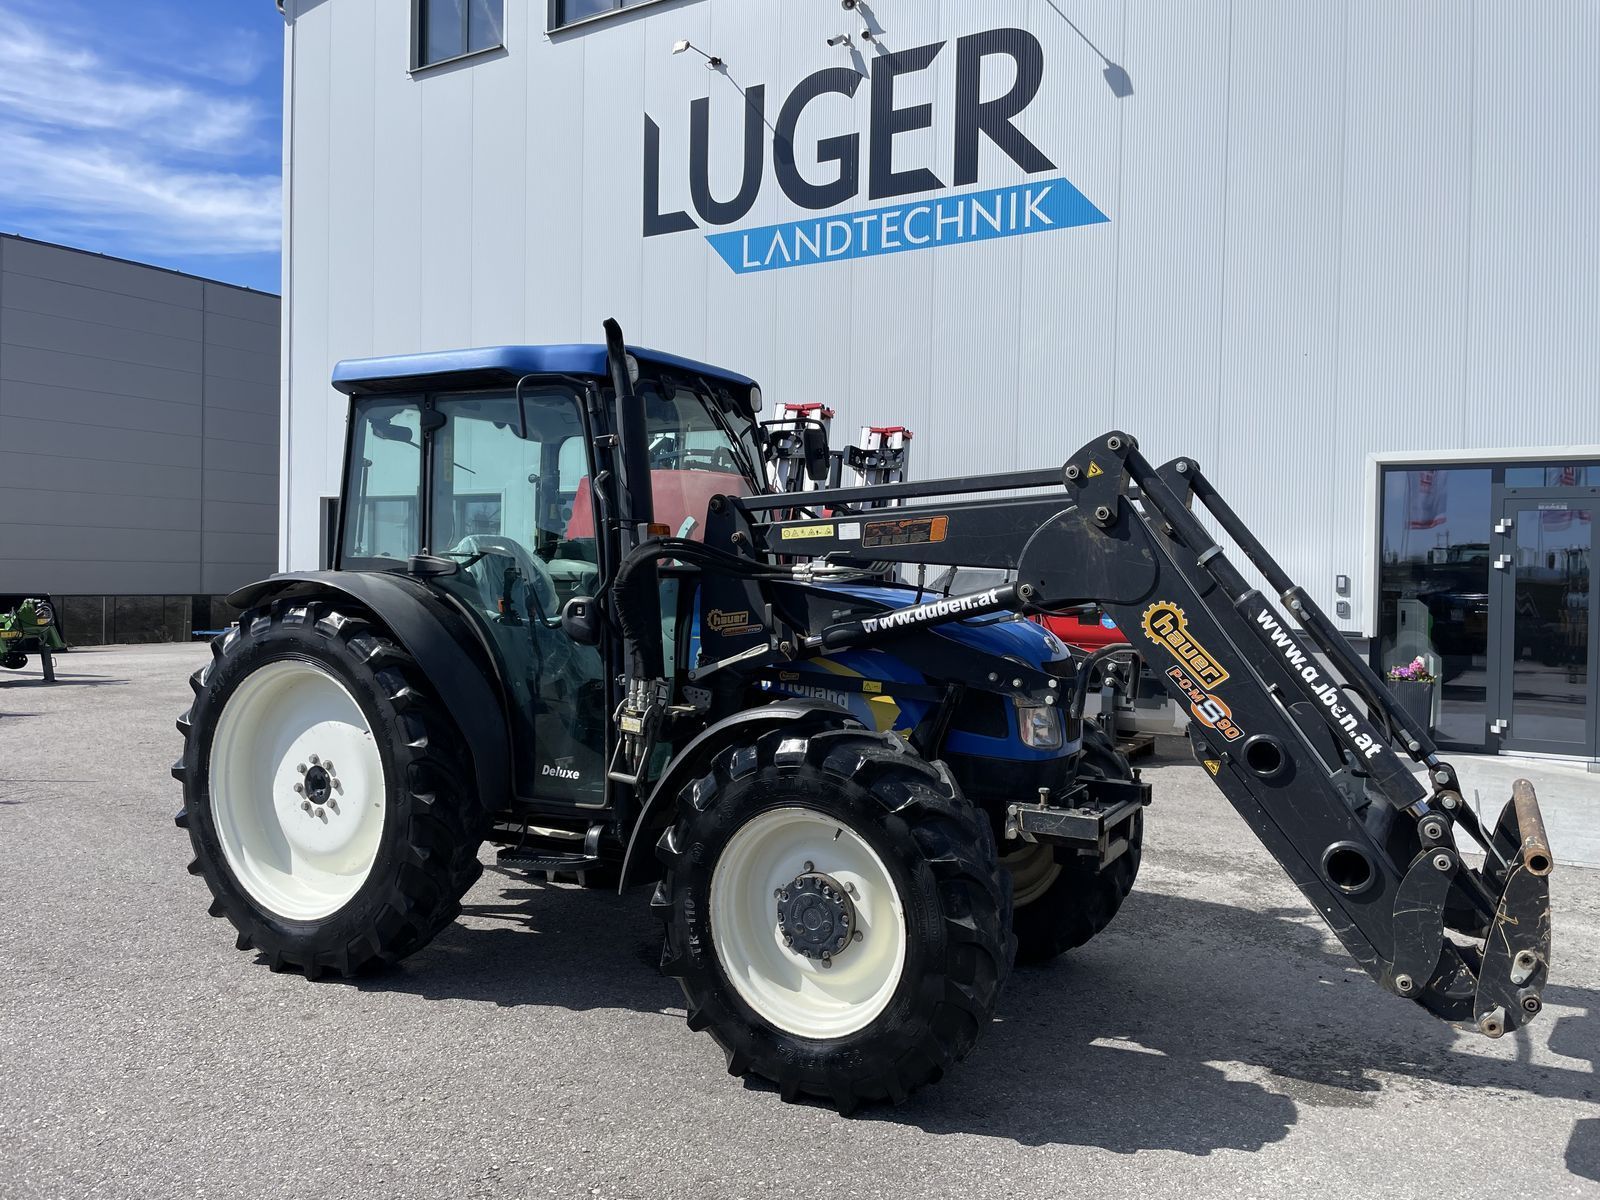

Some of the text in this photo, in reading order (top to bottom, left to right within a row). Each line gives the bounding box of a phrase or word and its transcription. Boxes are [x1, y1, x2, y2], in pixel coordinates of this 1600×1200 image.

[643, 27, 1058, 237] LUGER
[742, 185, 1055, 268] LANDTECHNIK
[861, 588, 999, 633] www.duben.at
[541, 764, 580, 780] Deluxe
